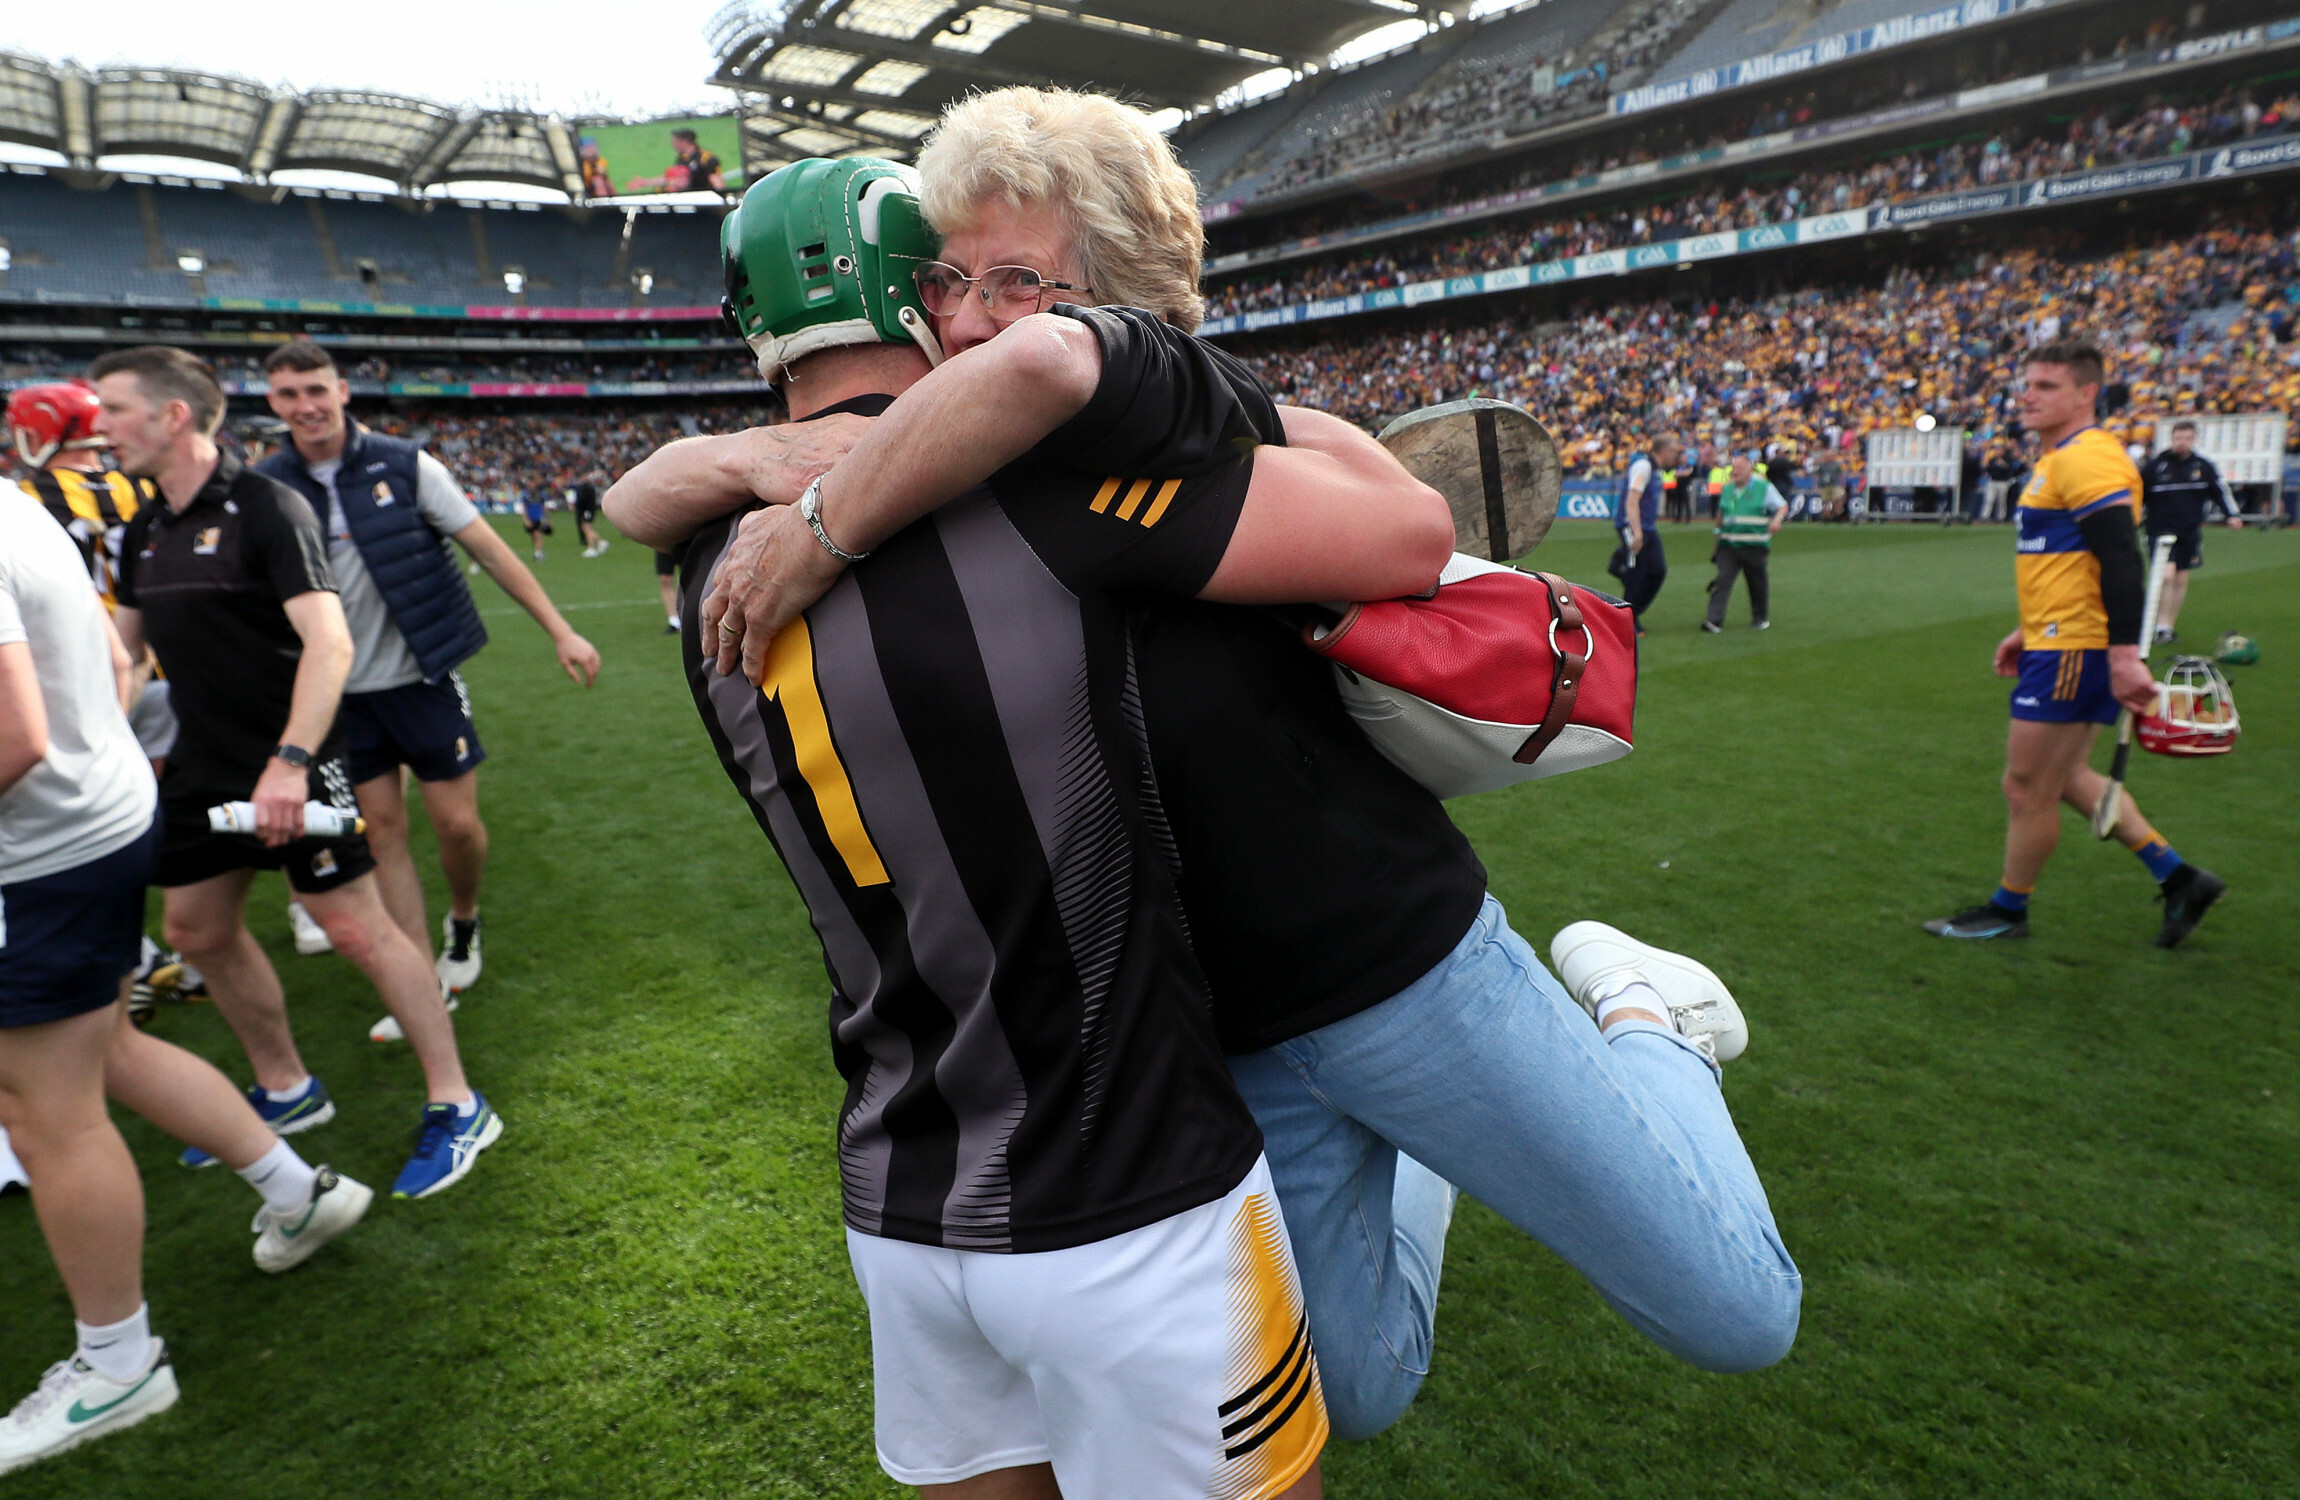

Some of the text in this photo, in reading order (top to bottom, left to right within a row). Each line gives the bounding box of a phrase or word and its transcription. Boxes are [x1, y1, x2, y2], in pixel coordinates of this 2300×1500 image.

[1870, 9, 1960, 50] Allianz
[1736, 47, 1814, 86] Allianz
[1623, 81, 1690, 115] Allianz
[1814, 216, 1850, 235] GAA
[1692, 237, 1725, 255] GAA
[1750, 227, 1787, 247] GAA
[1586, 255, 1614, 271] GAA
[1635, 247, 1668, 267] GAA
[1494, 271, 1519, 287] GAA
[1537, 263, 1567, 283] GAA
[1451, 277, 1478, 296] GAA
[1306, 300, 1345, 318] Allianz
[1567, 494, 1610, 518] GAA
[761, 612, 890, 887] 1
